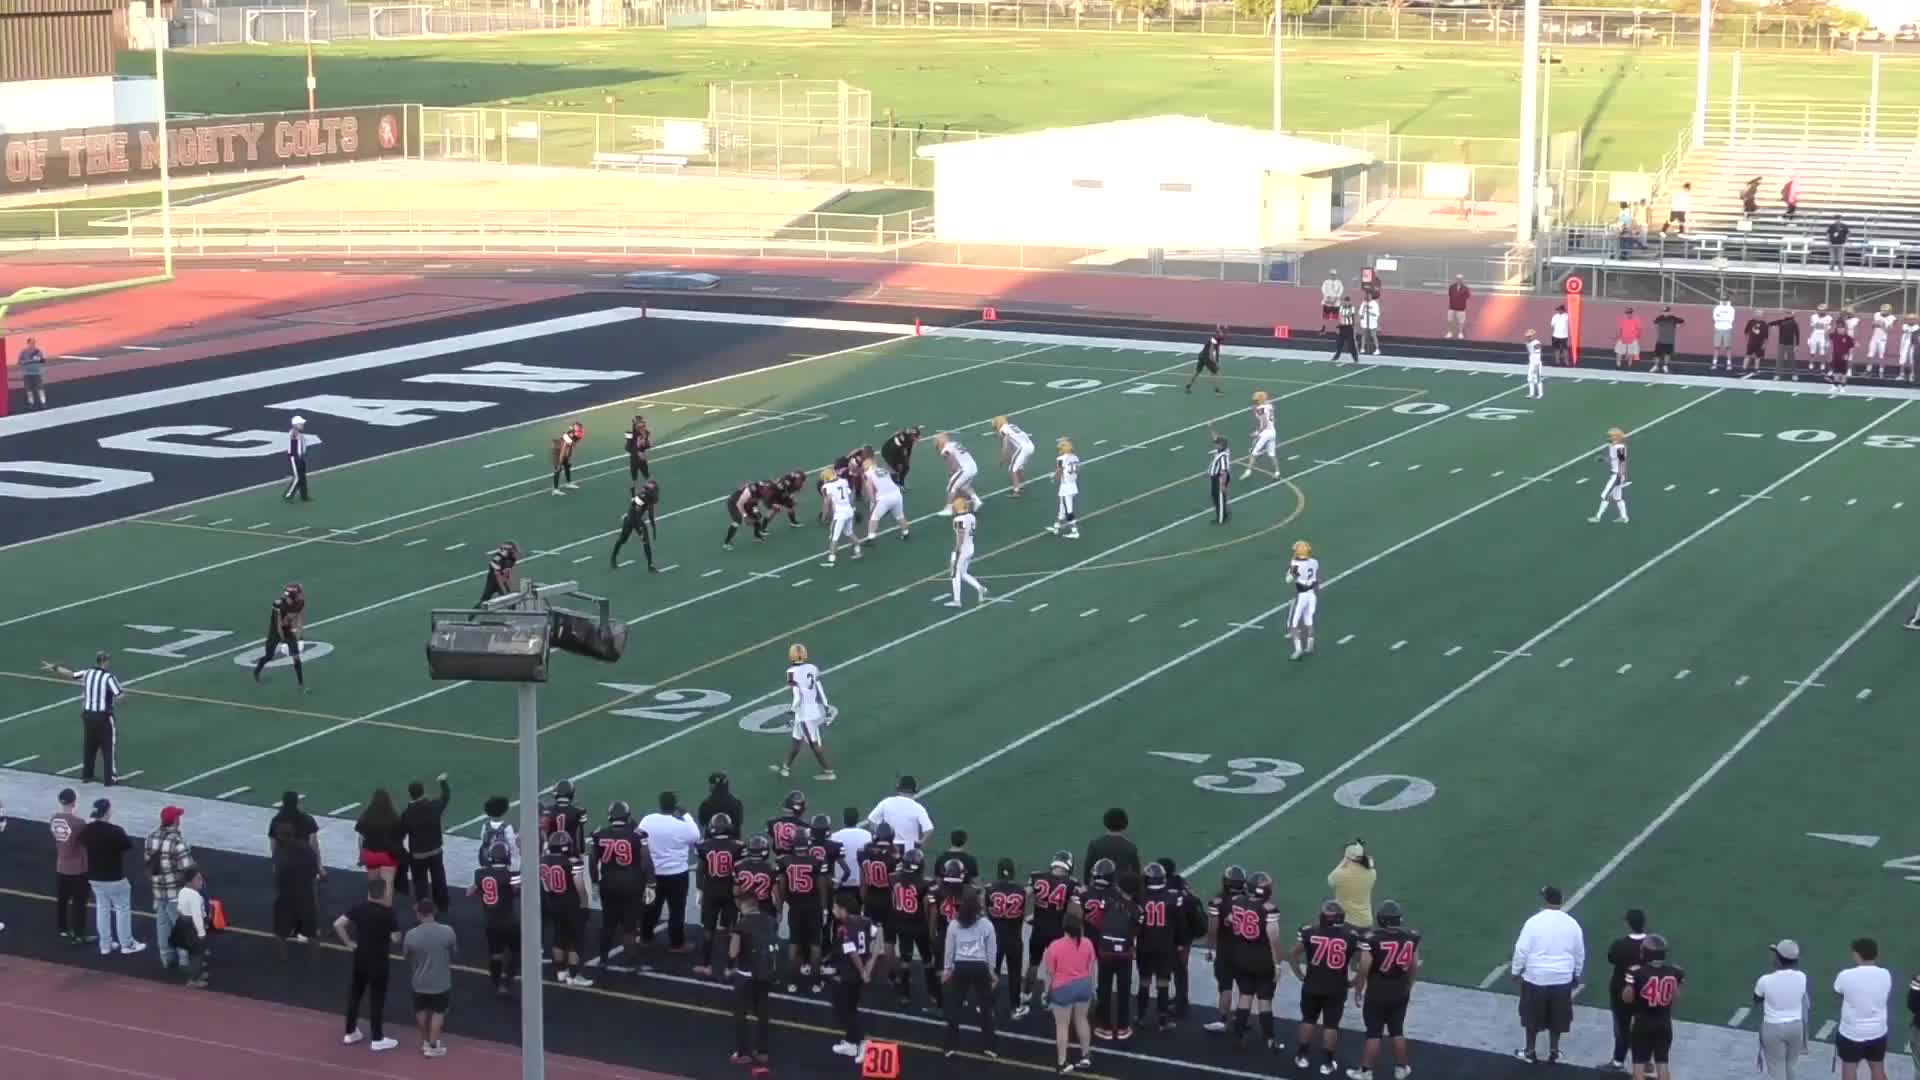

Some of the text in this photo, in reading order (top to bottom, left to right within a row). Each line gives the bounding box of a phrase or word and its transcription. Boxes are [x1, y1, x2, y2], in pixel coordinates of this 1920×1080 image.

[6, 116, 358, 182] OF THE MIGHTY COLTS
[1193, 757, 1437, 811] 30
[555, 812, 566, 833] 1
[773, 821, 797, 850] 19
[599, 838, 633, 866] 79
[706, 849, 733, 878] 18
[737, 870, 770, 900] 22
[786, 863, 814, 893] 15
[863, 860, 888, 888] 10
[481, 876, 498, 905] 9
[895, 883, 918, 913] 16
[989, 891, 1025, 919] 32
[1034, 879, 1067, 911] 24
[1145, 901, 1166, 927] 11
[1231, 904, 1261, 940] 56
[1310, 935, 1348, 969] 76
[1380, 940, 1414, 973] 74
[1640, 975, 1679, 1008] 40
[866, 1047, 893, 1075] 30
